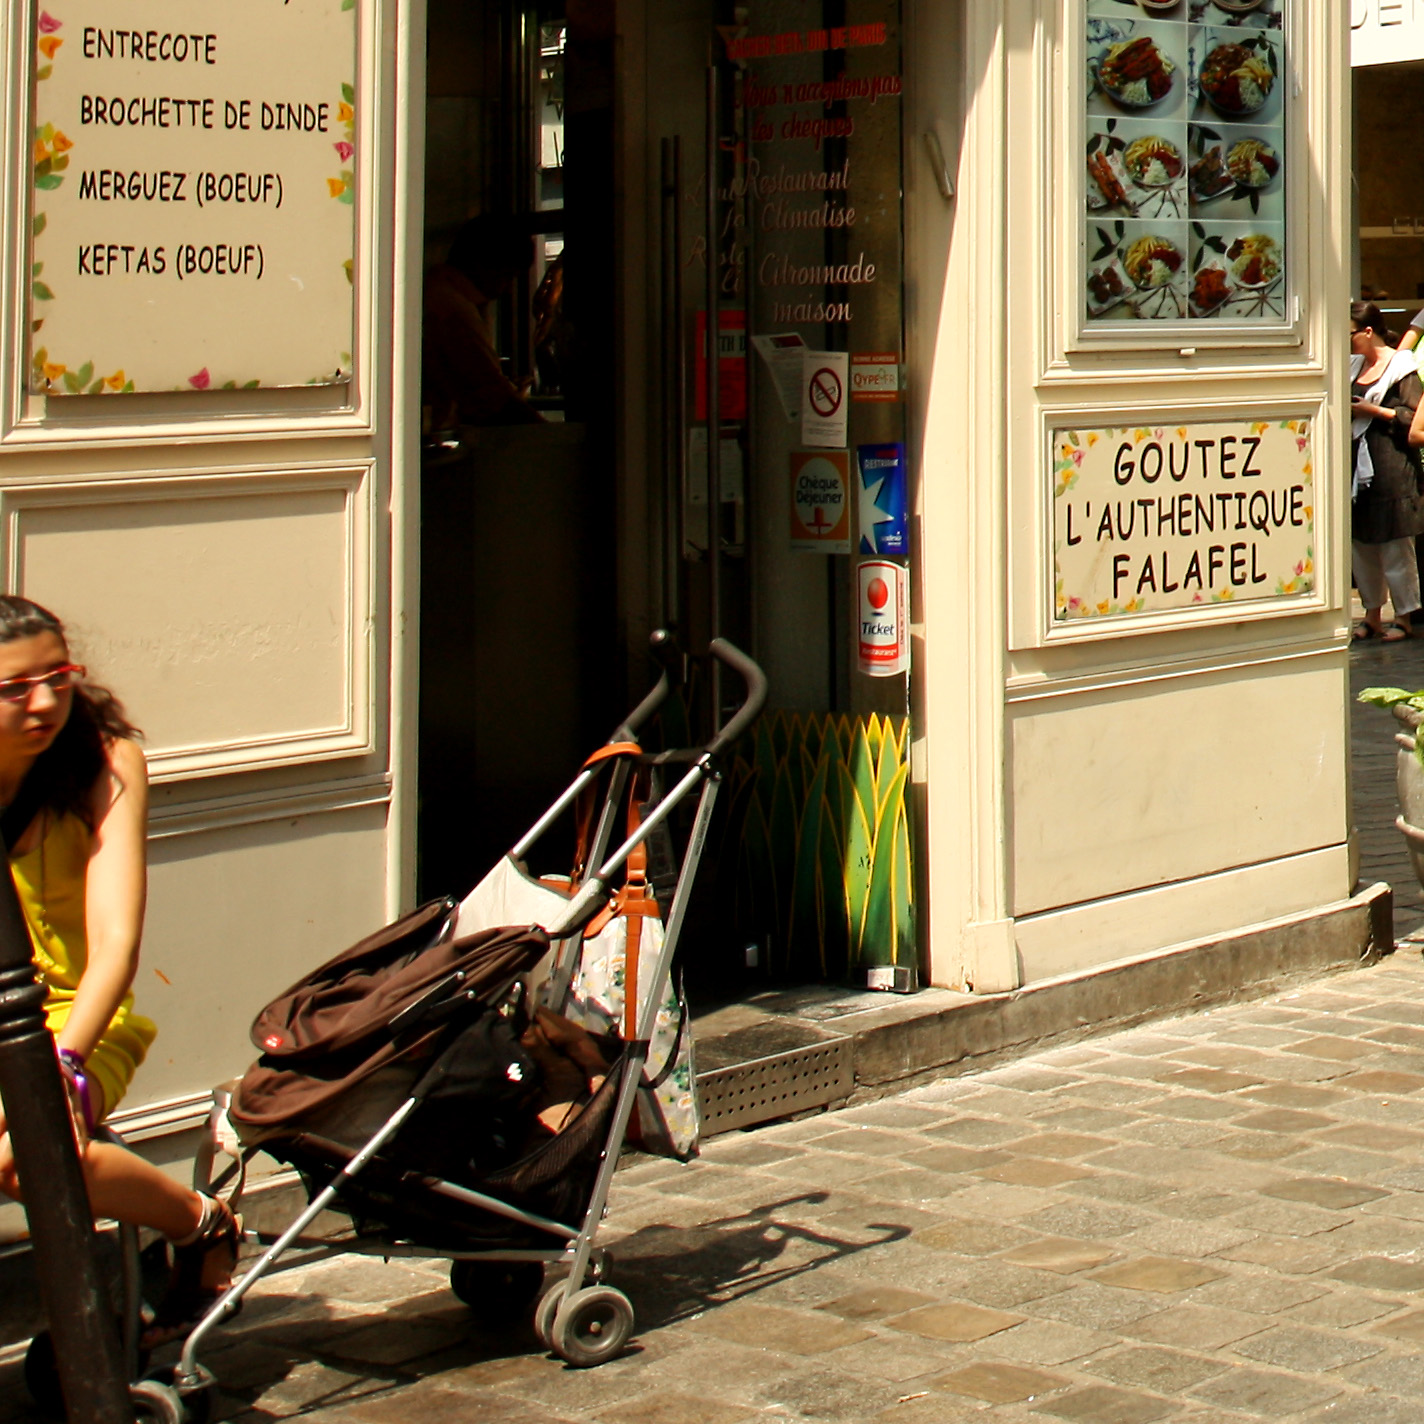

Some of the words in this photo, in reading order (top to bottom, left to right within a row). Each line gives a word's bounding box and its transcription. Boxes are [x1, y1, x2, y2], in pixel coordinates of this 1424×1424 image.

[82, 27, 217, 65] ENTRECOTE
[80, 95, 215, 130] BROCHETTE
[224, 100, 251, 130] DE
[261, 101, 329, 133] DINDE
[79, 170, 186, 202] MERGUEZ
[196, 173, 283, 209] (BOEUF)
[744, 156, 851, 200] Restaurant
[78, 244, 166, 275] KEFTAS
[175, 244, 265, 281] (BOEUF)
[760, 252, 876, 287] Citronnade
[774, 294, 853, 324] maison
[1114, 436, 1261, 485] GOUTEZ
[796, 490, 843, 506] Déjeuner
[799, 476, 840, 491] Chèque
[1067, 485, 1303, 546] L'AUTHENTIQUE
[1113, 542, 1267, 599] FALAFEL
[862, 622, 895, 636] Ticket
